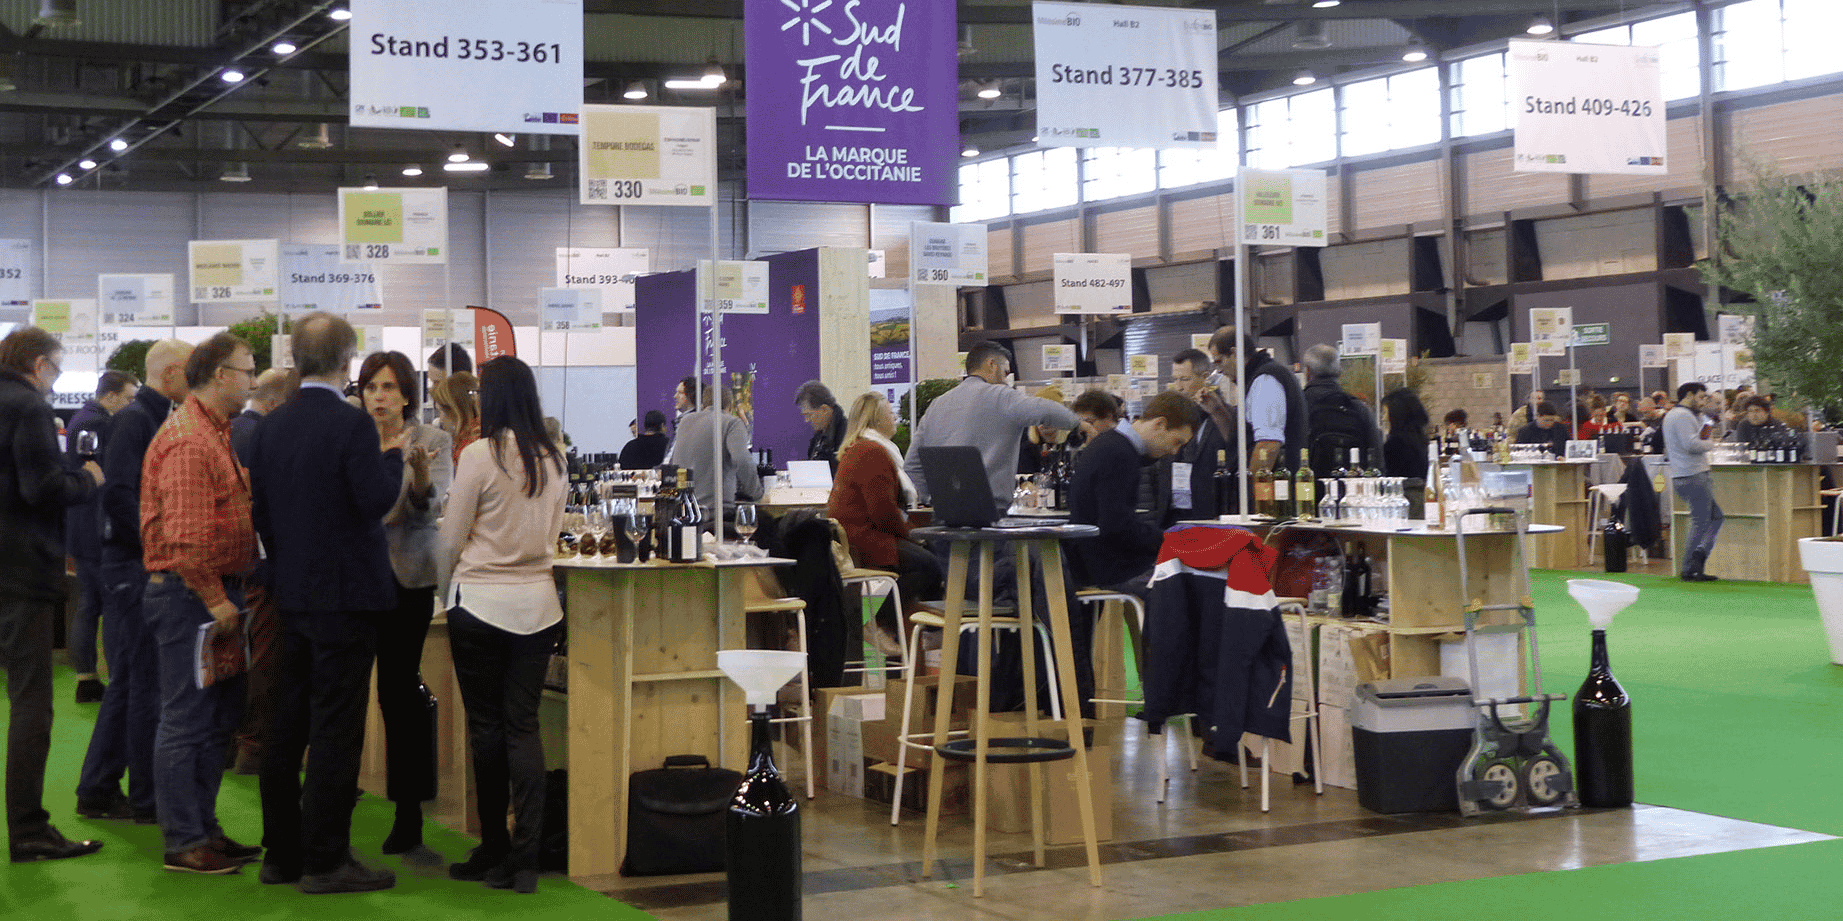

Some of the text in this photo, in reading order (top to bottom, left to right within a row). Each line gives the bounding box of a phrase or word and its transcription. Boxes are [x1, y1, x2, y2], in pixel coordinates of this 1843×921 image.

[832, 0, 905, 52] Sud
[371, 33, 560, 64] Stand 353-361
[839, 43, 887, 81] de
[1052, 63, 1203, 89] Stand 377-385
[796, 55, 925, 126] France
[1525, 95, 1652, 117] Stand 409-426
[805, 145, 908, 166] LA MARQUE
[787, 162, 812, 179] DE
[614, 180, 643, 199] 330
[1262, 225, 1280, 239] 361
[366, 244, 390, 259] 328
[291, 273, 375, 283] Stand 369-376
[564, 274, 596, 284] Stand
[932, 269, 949, 281] 360
[1061, 279, 1126, 288] Stand 482-497
[212, 286, 232, 299] 326
[118, 313, 135, 323] 324
[555, 321, 570, 330] 358
